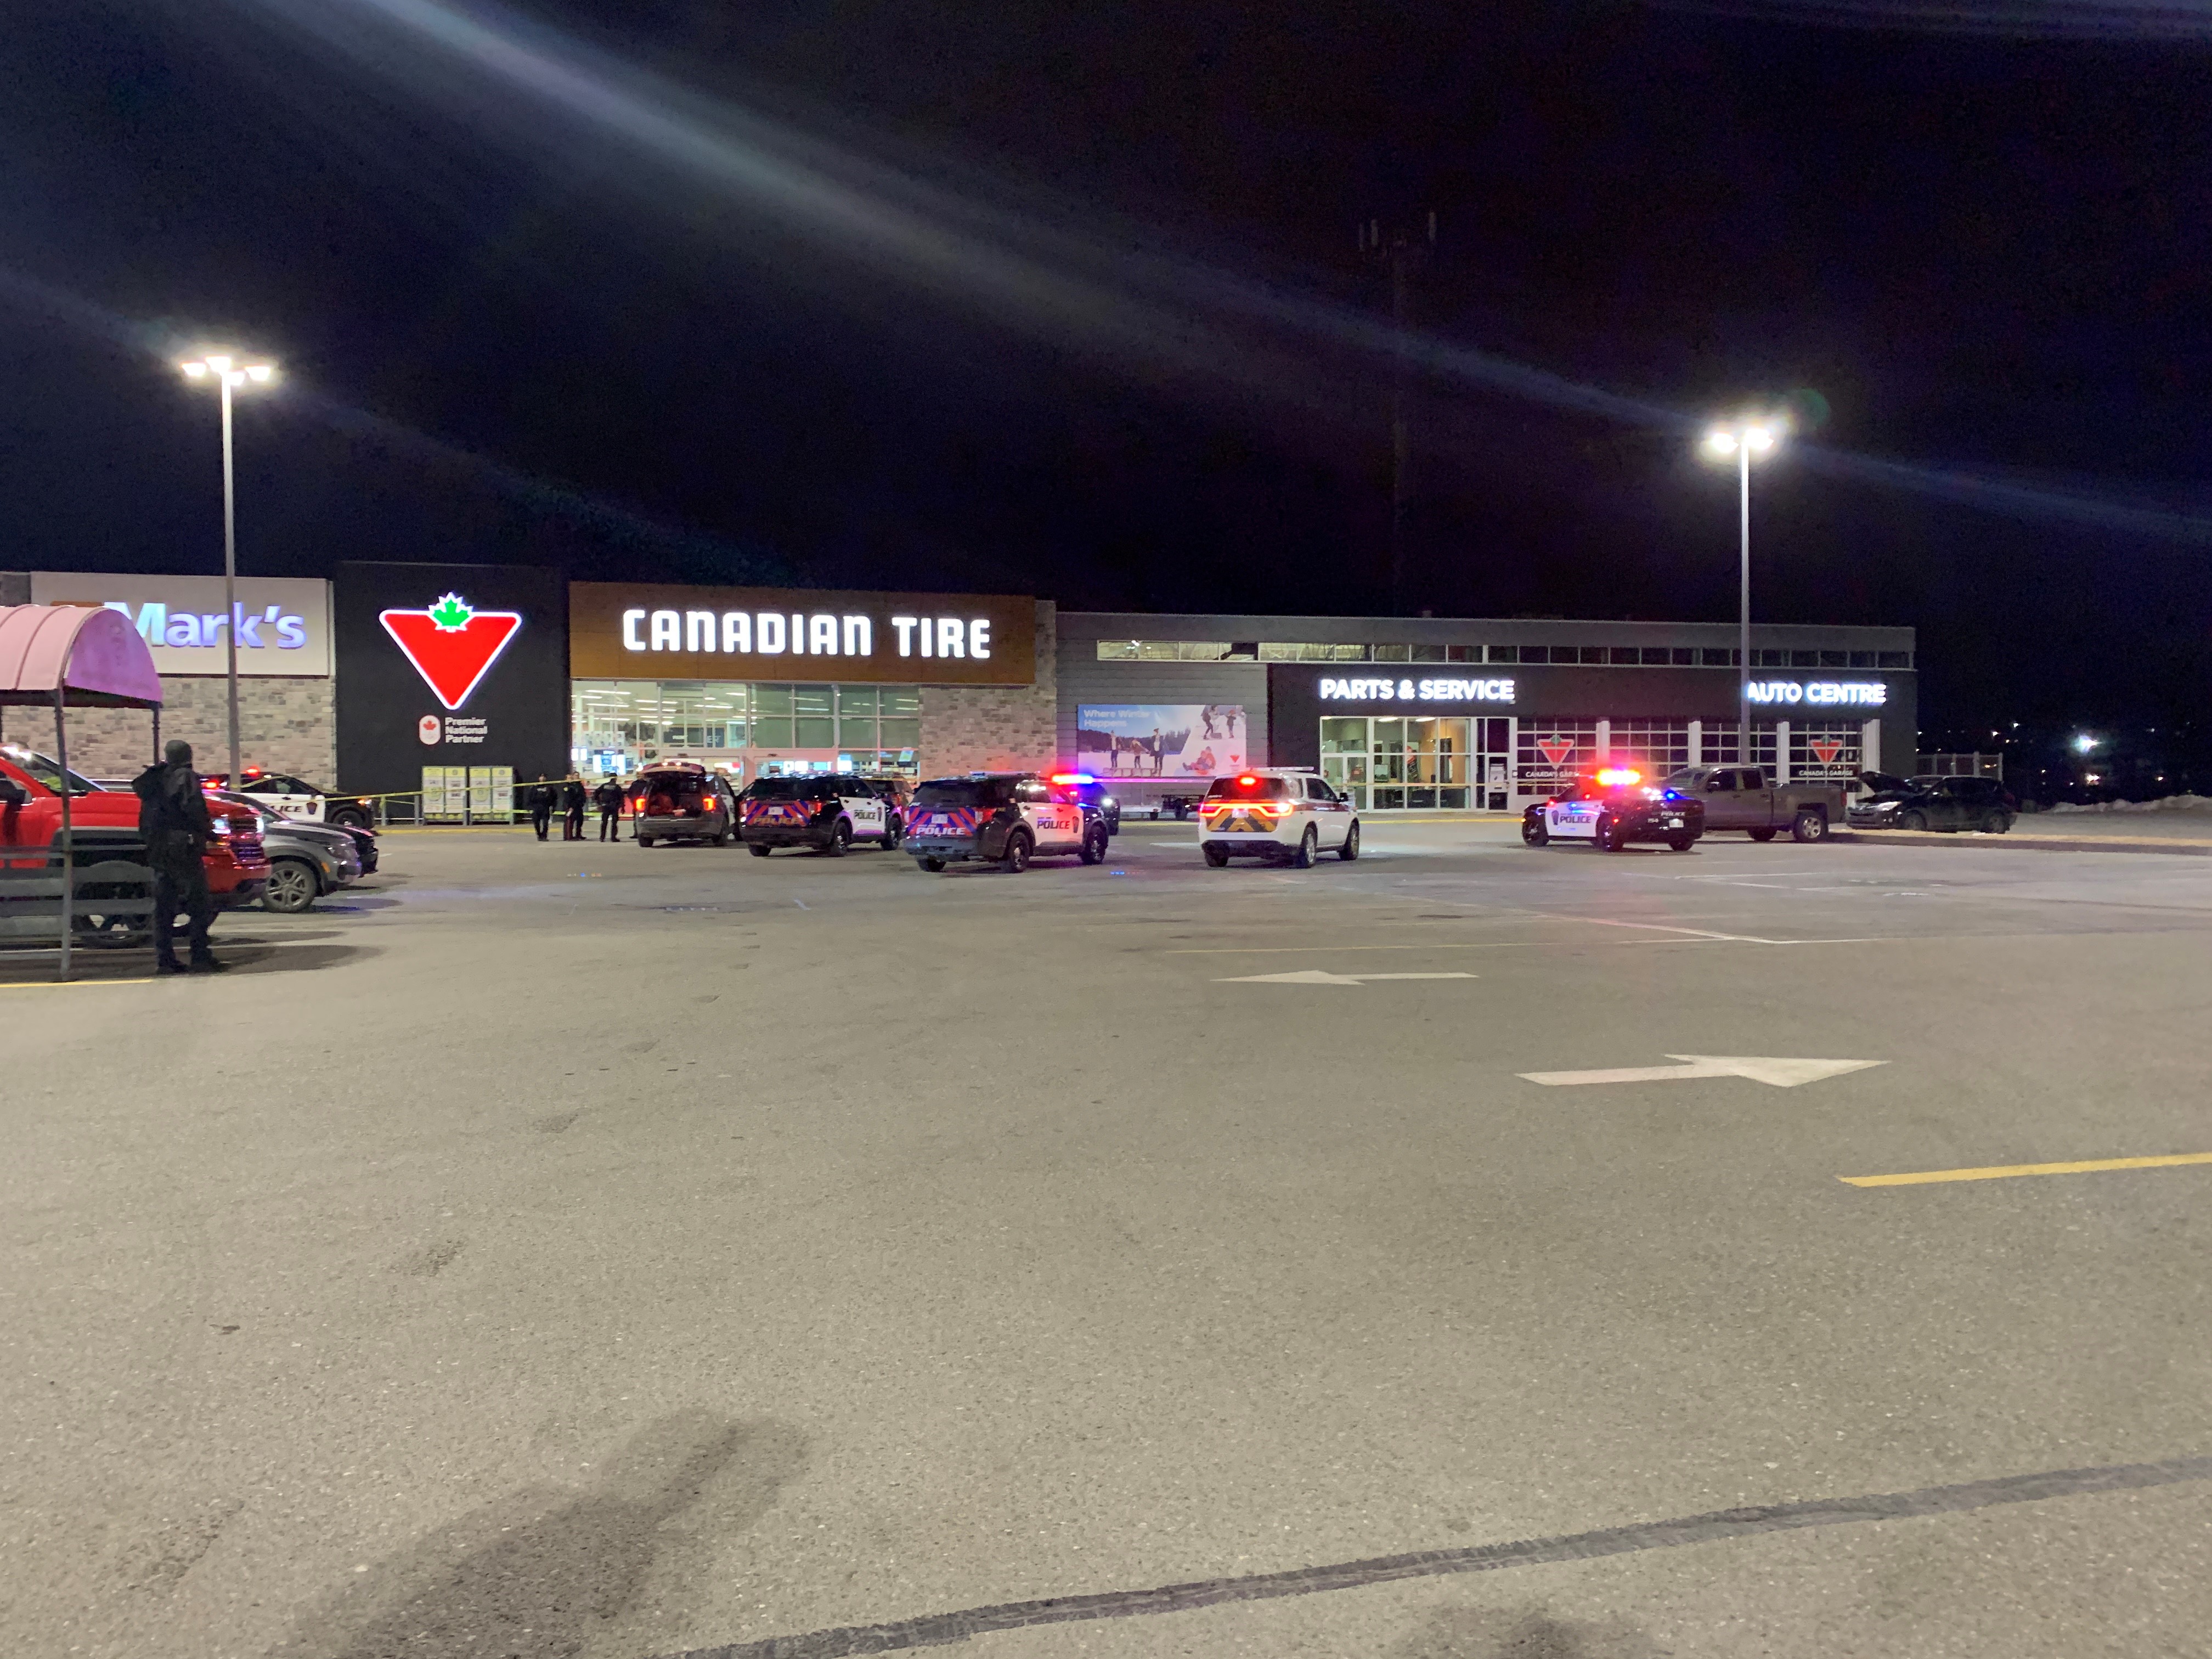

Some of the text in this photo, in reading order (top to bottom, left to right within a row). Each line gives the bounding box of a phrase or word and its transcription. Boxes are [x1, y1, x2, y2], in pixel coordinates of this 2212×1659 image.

[104, 601, 307, 648] Mark's
[623, 610, 990, 658] CANADIAN TIRE
[1321, 679, 1515, 699] PARTS & SERVICE
[1748, 682, 1887, 703] AUTO CENTRE
[445, 717, 486, 725] Premier
[445, 726, 488, 734] National
[445, 735, 484, 743] Partner
[1036, 821, 1070, 829] POLICE
[916, 827, 966, 835] POLICE
